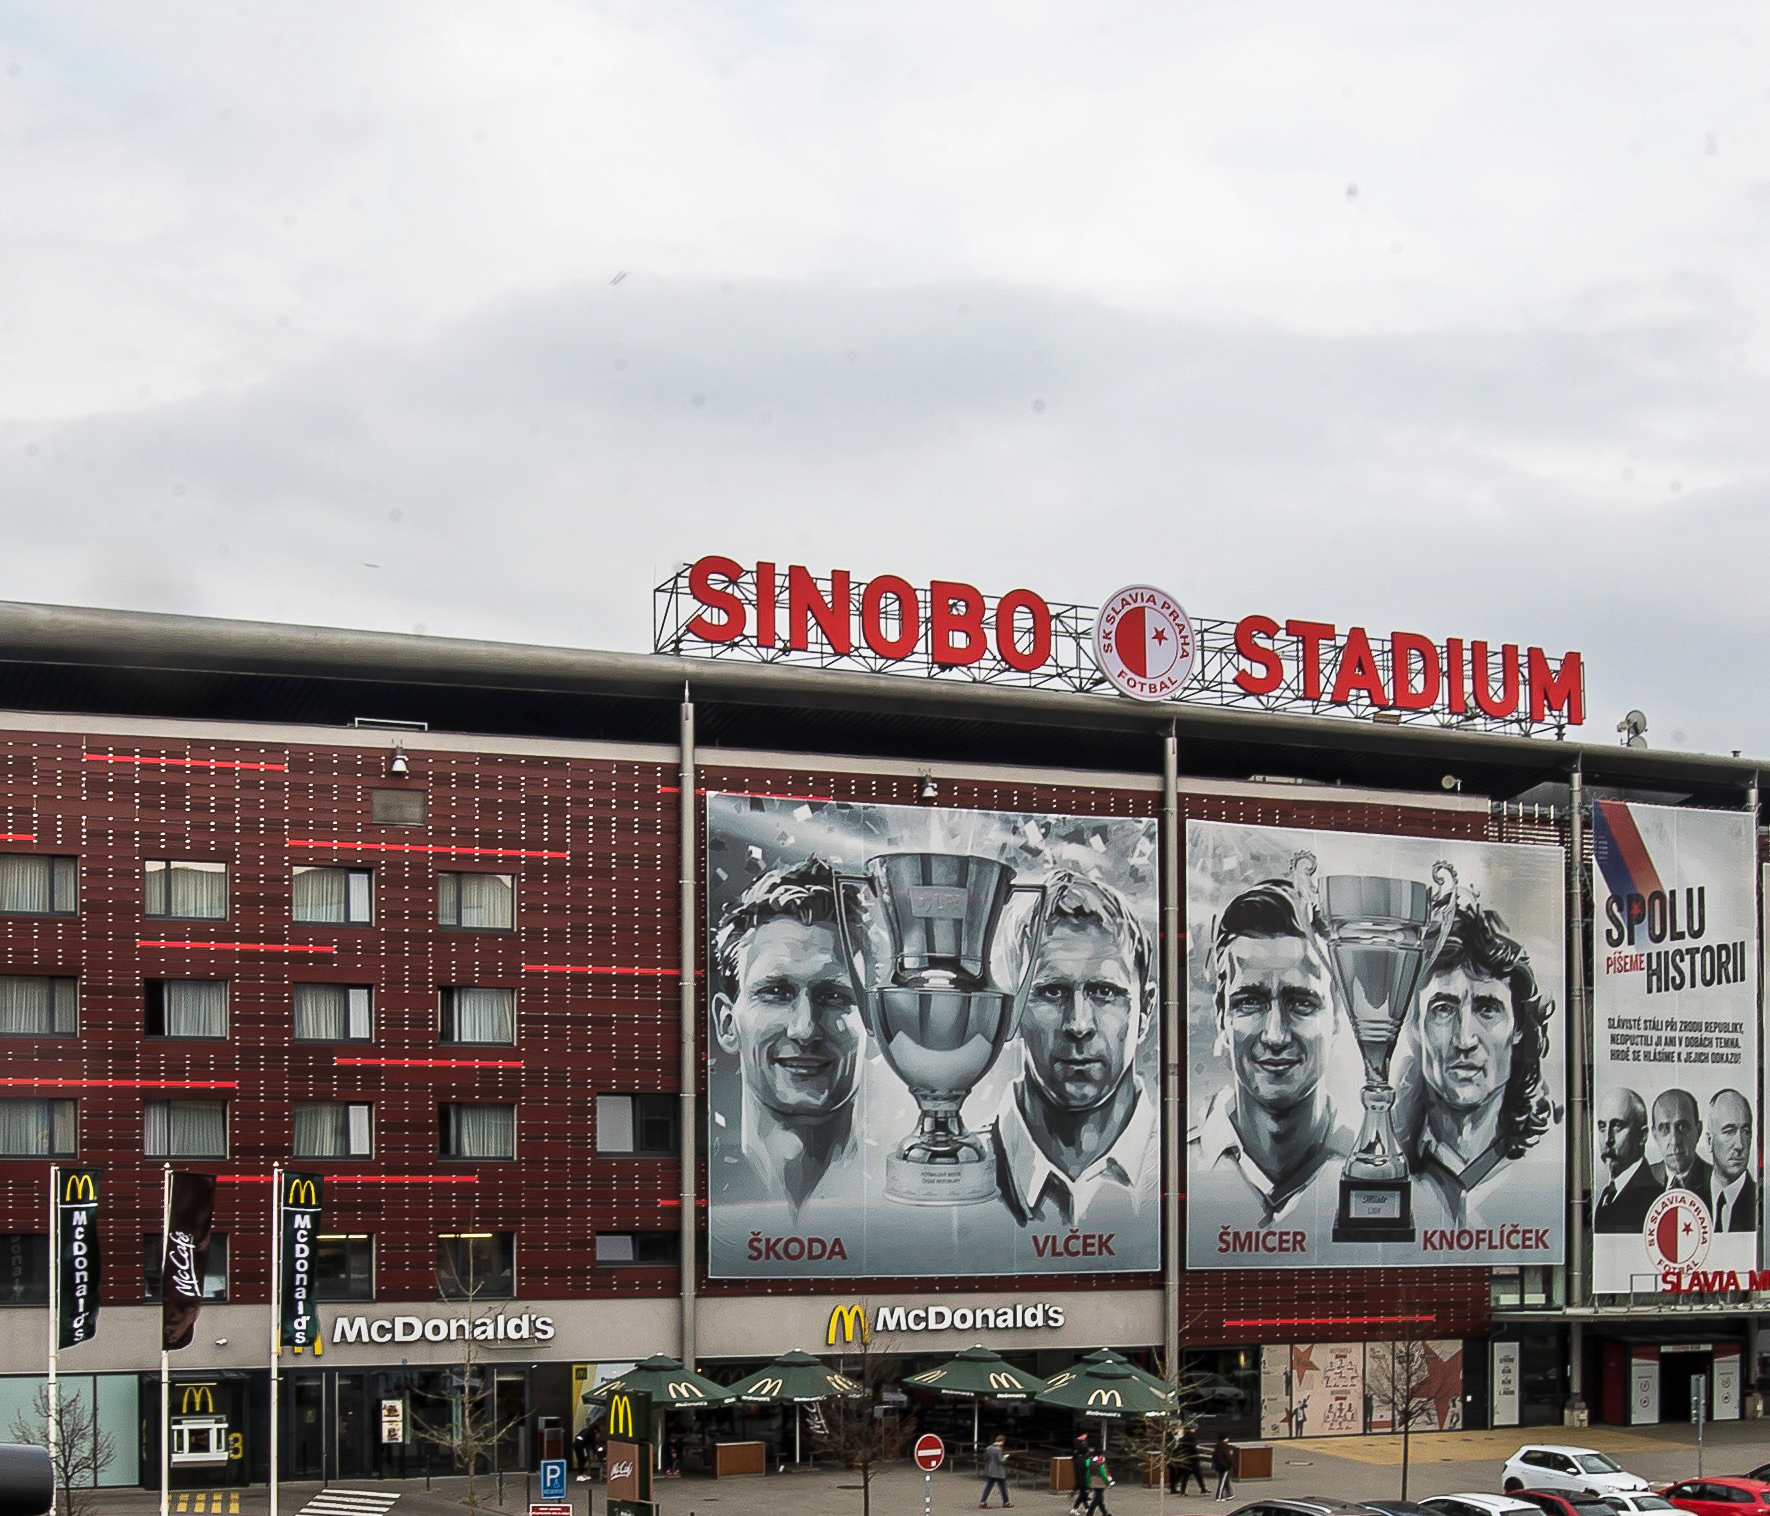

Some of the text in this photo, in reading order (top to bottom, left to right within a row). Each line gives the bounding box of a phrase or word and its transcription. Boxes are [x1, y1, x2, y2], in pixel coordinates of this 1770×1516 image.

[1102, 592, 1190, 659] SK SLAVIA PRAHA
[687, 556, 1583, 726] SINOBO STADIUM
[1117, 669, 1177, 693] FOTBAL
[1605, 886, 1705, 948] SPOLU
[1606, 941, 1746, 994] PÍŠEME HISTORII
[1651, 1195, 1687, 1223] SLAVIA
[746, 1231, 847, 1261] ŠKODA
[1031, 1229, 1116, 1258] VLČEK
[1217, 1225, 1307, 1253] ŠMICER
[1422, 1223, 1550, 1250] KNOFLÍČEK
[72, 1210, 88, 1342] McDonald's
[294, 1214, 312, 1343] McDonald's
[1661, 1270, 1740, 1293] SLAVIA
[332, 1313, 556, 1343] McDonald's
[876, 1303, 1065, 1331] McDonald's
[546, 1465, 561, 1487] P
